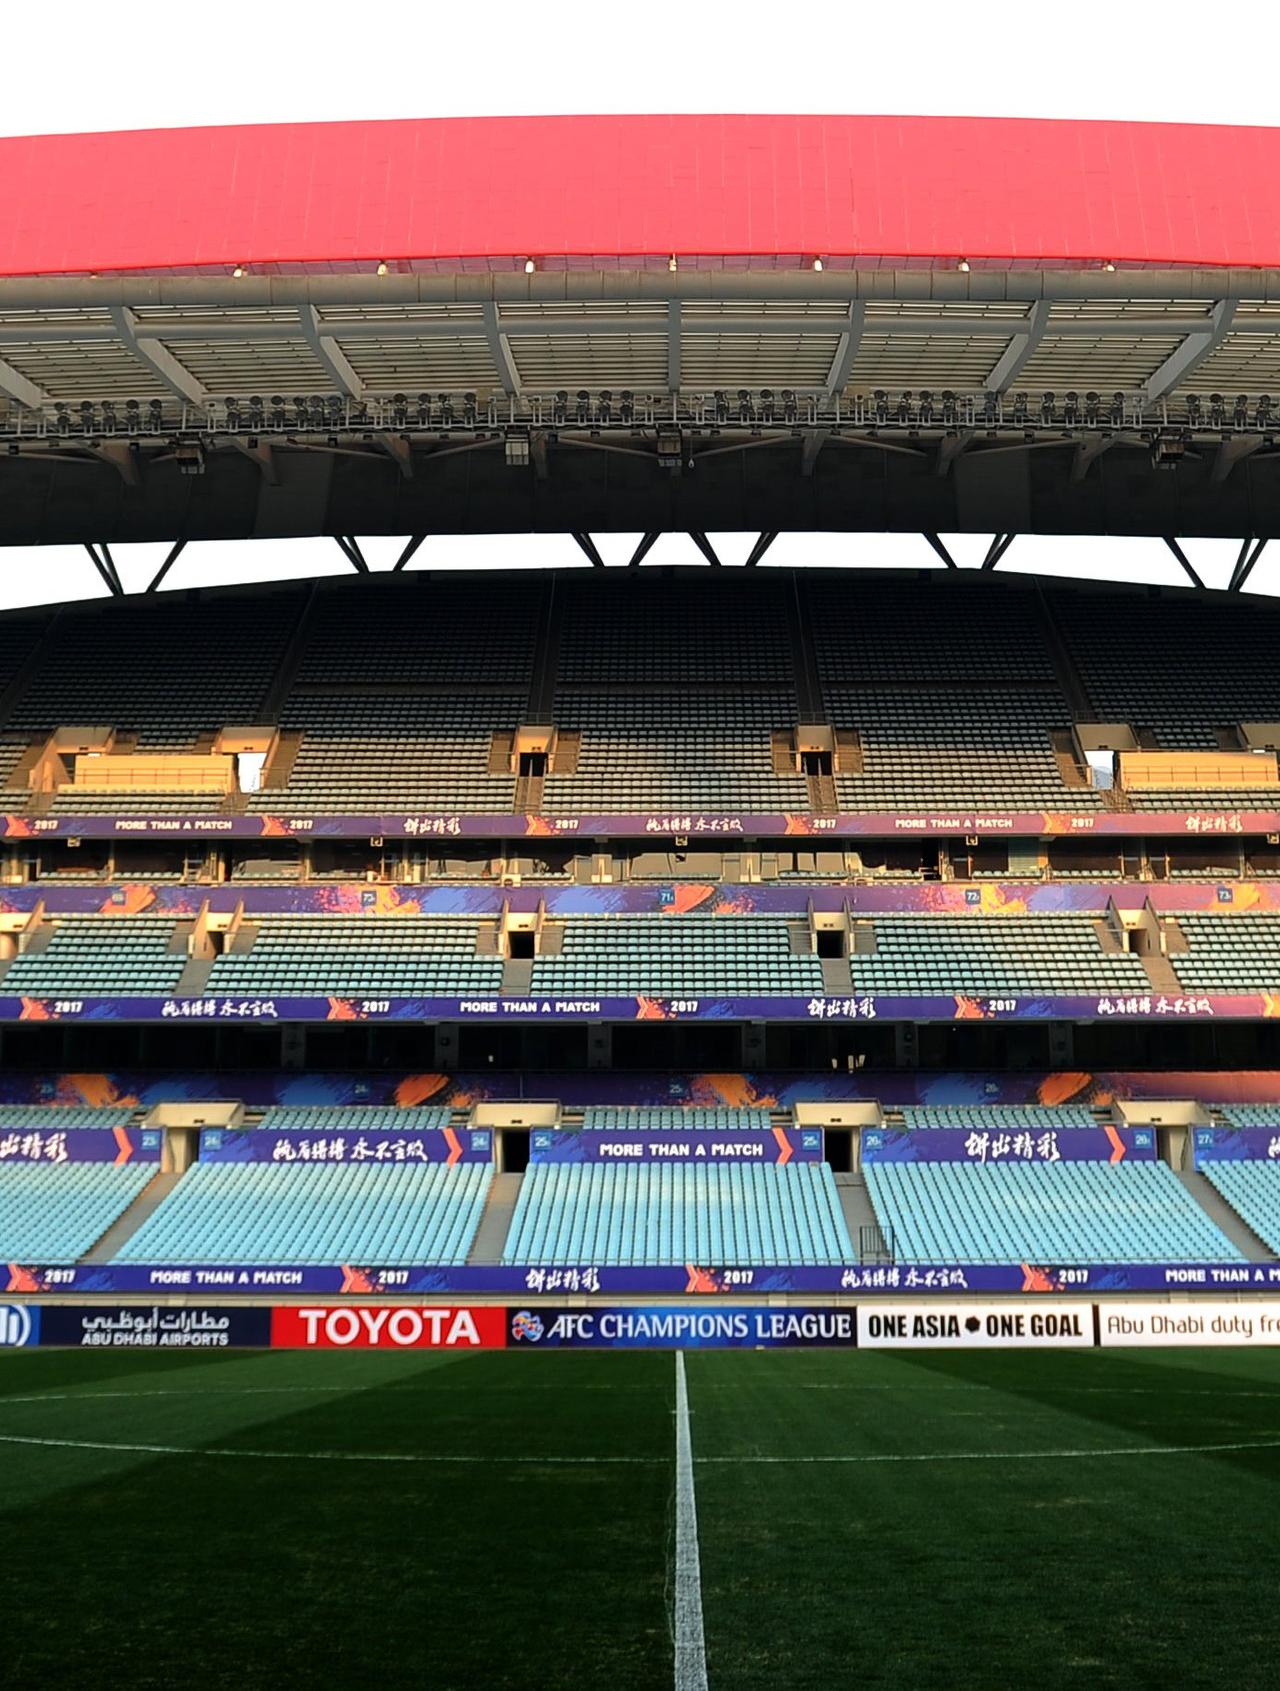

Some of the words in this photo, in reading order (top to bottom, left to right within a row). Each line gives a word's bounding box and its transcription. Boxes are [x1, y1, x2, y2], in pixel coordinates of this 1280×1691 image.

[116, 821, 147, 829] MORE
[151, 821, 180, 829] THAN
[195, 821, 232, 829] MATCH
[555, 820, 578, 833] 2017
[814, 819, 835, 828] 2017
[896, 820, 926, 828] MORE
[975, 819, 1012, 827] MATCH
[1072, 819, 1093, 827] 2017
[55, 1002, 82, 1012] 2017
[361, 1001, 389, 1013] 2017
[461, 1002, 497, 1012] MORE
[502, 1002, 537, 1012] THAN
[542, 1003, 550, 1012] A
[556, 1002, 599, 1012] MATCH
[670, 1001, 697, 1013] 2017
[990, 1000, 1016, 1010] 2017
[600, 1144, 643, 1156] MORE
[649, 1144, 689, 1155] THAN
[695, 1144, 706, 1155] A
[712, 1144, 762, 1155] MATCH
[45, 1270, 75, 1282] 2017
[151, 1271, 190, 1283] MORE
[196, 1272, 234, 1283] THAN
[239, 1272, 248, 1283] A
[254, 1272, 302, 1283] MATCH
[379, 1271, 408, 1283] 2017
[725, 1271, 753, 1283] 2017
[1060, 1270, 1088, 1282] 2017
[1166, 1270, 1205, 1281] MORE
[1211, 1270, 1249, 1281] THAN
[1255, 1269, 1264, 1281] A
[299, 1309, 480, 1344] TOYOTA
[547, 1315, 593, 1338] AFC
[600, 1315, 748, 1337] CHAMPIONS
[756, 1315, 851, 1337] LEAGUE
[869, 1315, 907, 1337] ONE
[913, 1315, 960, 1337] ASIA
[987, 1315, 1025, 1337] ONE
[1031, 1315, 1082, 1336] GOAL
[1108, 1316, 1143, 1334] Abu
[1151, 1316, 1203, 1333] Dhabi
[1211, 1316, 1252, 1337] duty
[81, 1332, 112, 1345] ABU
[113, 1332, 157, 1345] DHABI
[159, 1332, 229, 1345] AIRPORTS
